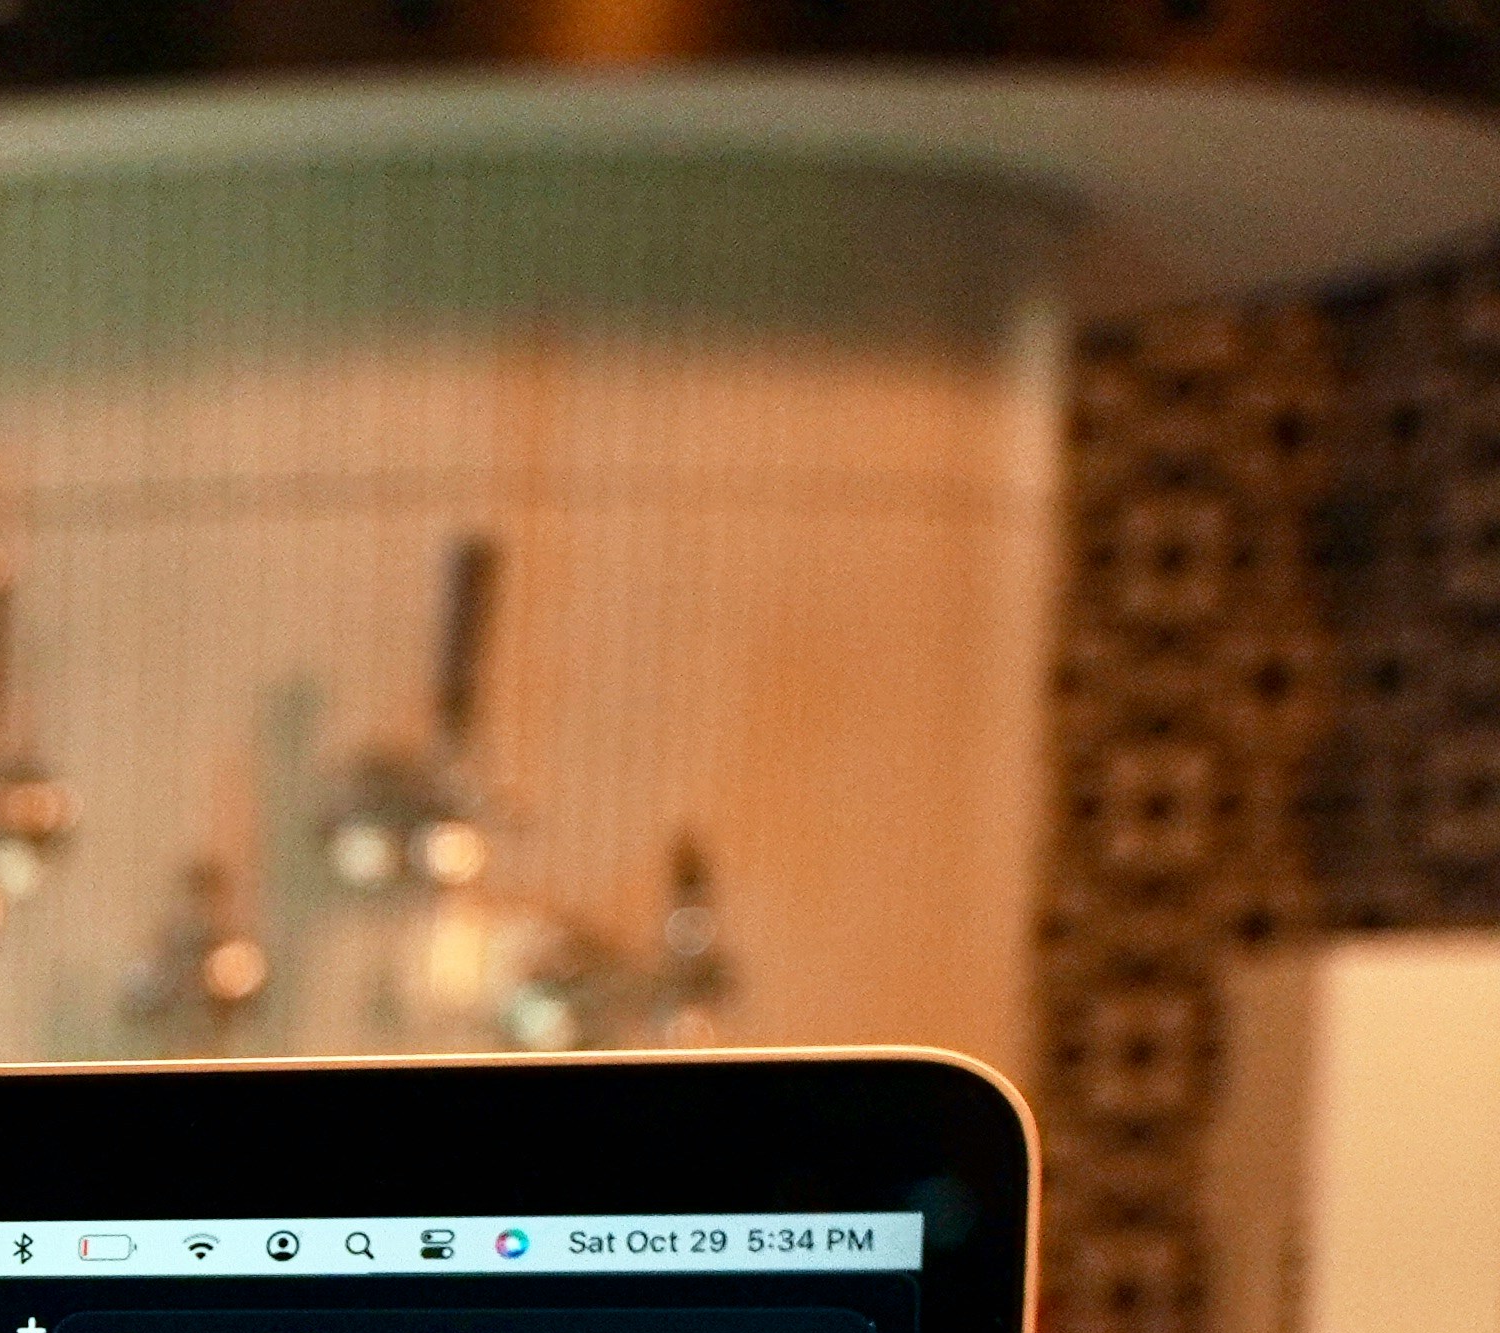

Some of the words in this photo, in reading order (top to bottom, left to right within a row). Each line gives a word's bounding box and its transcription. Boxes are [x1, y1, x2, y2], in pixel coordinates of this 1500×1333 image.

[568, 1230, 618, 1255] Sat
[625, 1229, 679, 1255] Oct
[690, 1228, 729, 1254] 29
[747, 1227, 815, 1254] 5:34
[826, 1227, 874, 1252] PM
